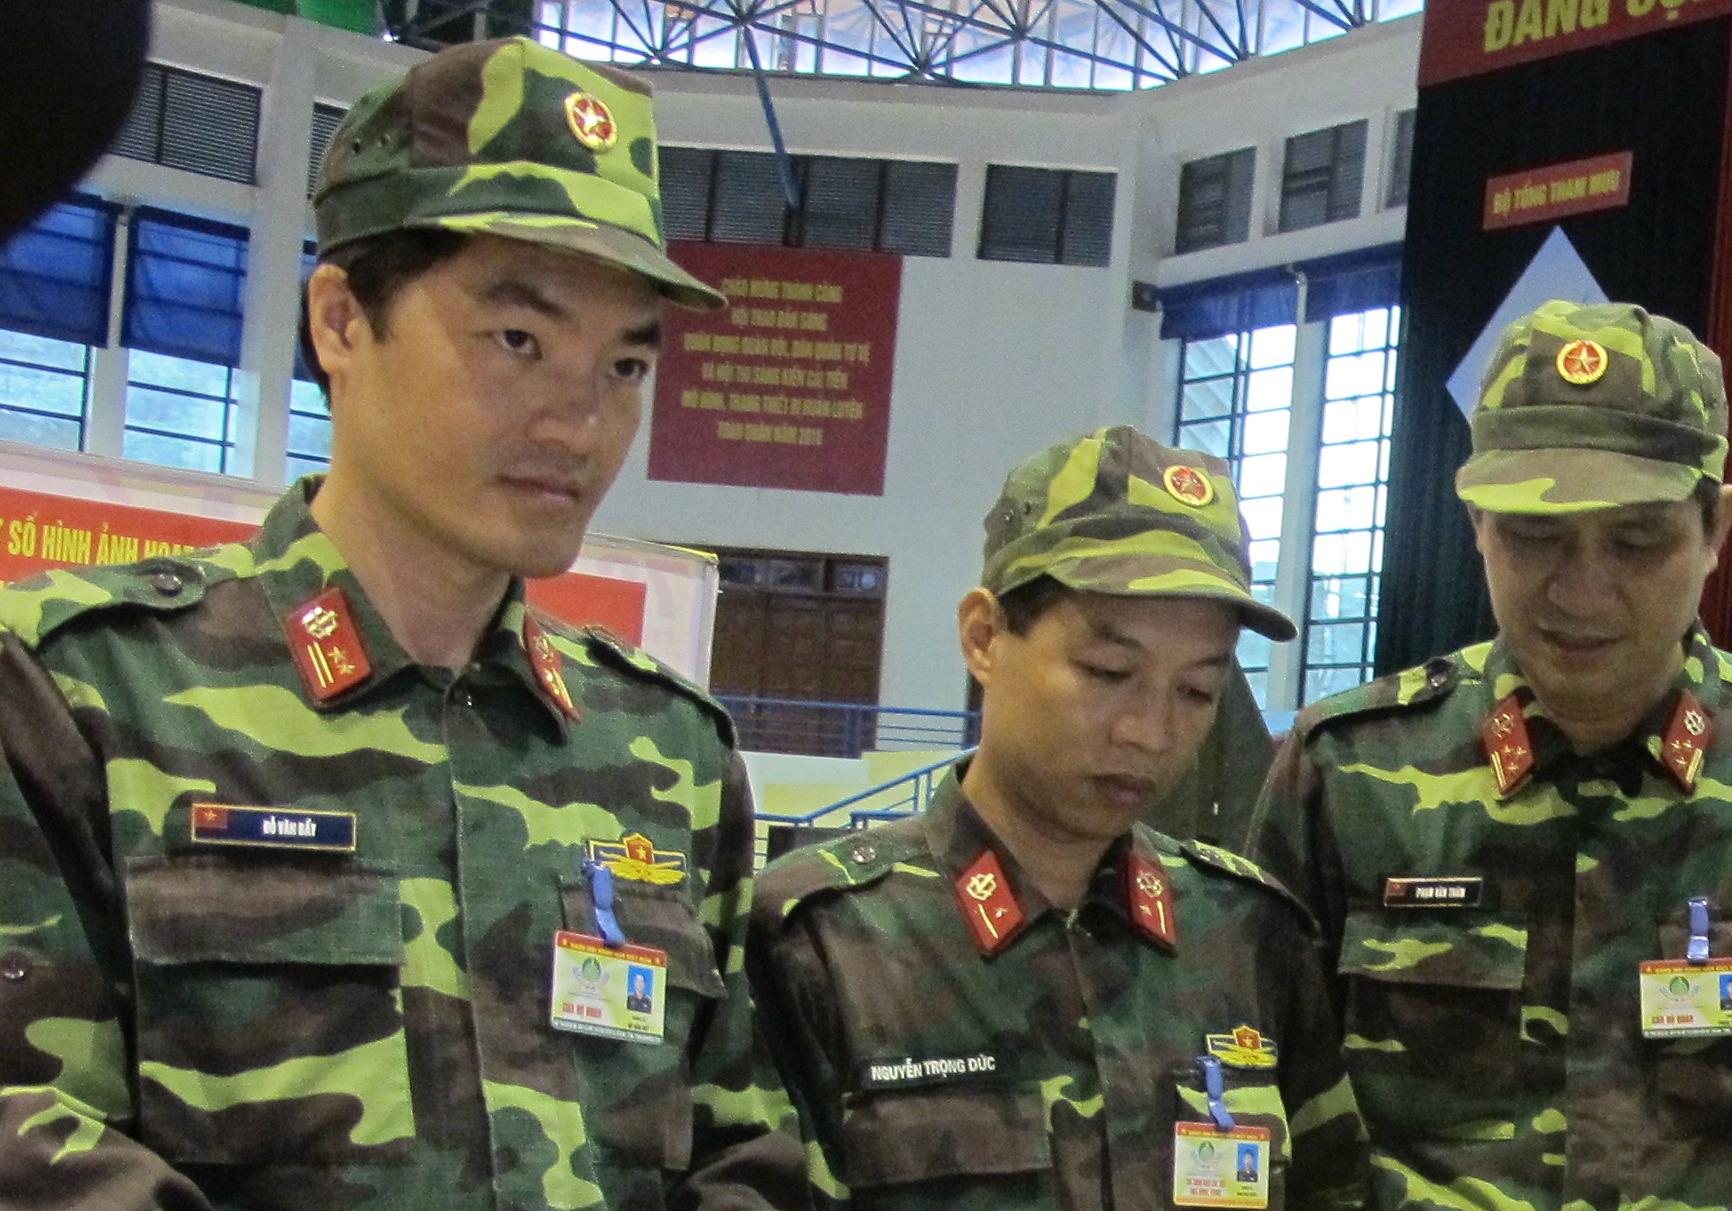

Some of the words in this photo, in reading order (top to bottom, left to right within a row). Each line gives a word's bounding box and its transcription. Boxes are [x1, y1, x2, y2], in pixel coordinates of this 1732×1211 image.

[7, 511, 38, 558] SỐ
[41, 519, 92, 565] HÌNH
[96, 521, 139, 566] ẢNH
[870, 1058, 922, 1081] NGUYỄN
[922, 1059, 966, 1078] TRỌNG
